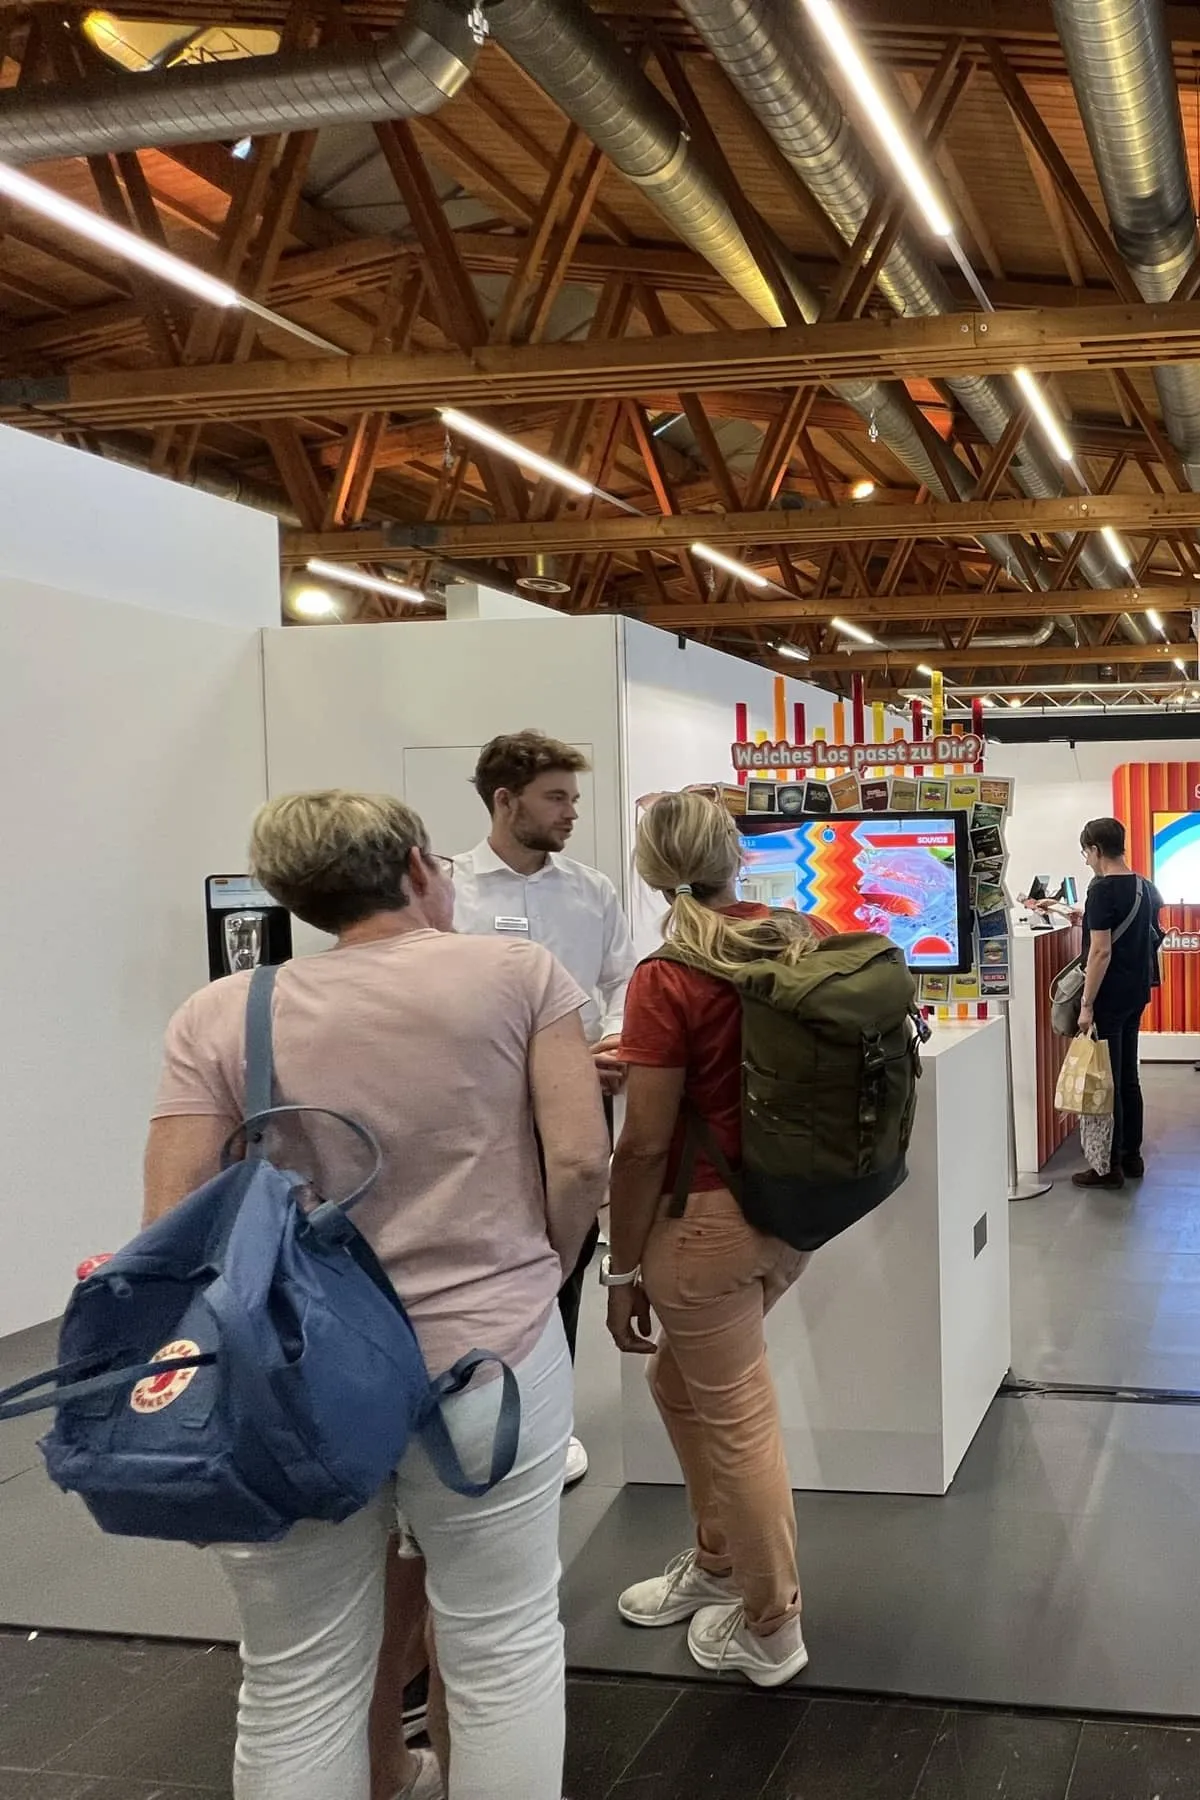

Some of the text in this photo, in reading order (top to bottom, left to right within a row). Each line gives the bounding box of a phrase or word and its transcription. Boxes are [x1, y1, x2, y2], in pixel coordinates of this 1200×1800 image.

[735, 740, 976, 766] Welches Los passt zu Dir?
[1162, 932, 1199, 948] ches
